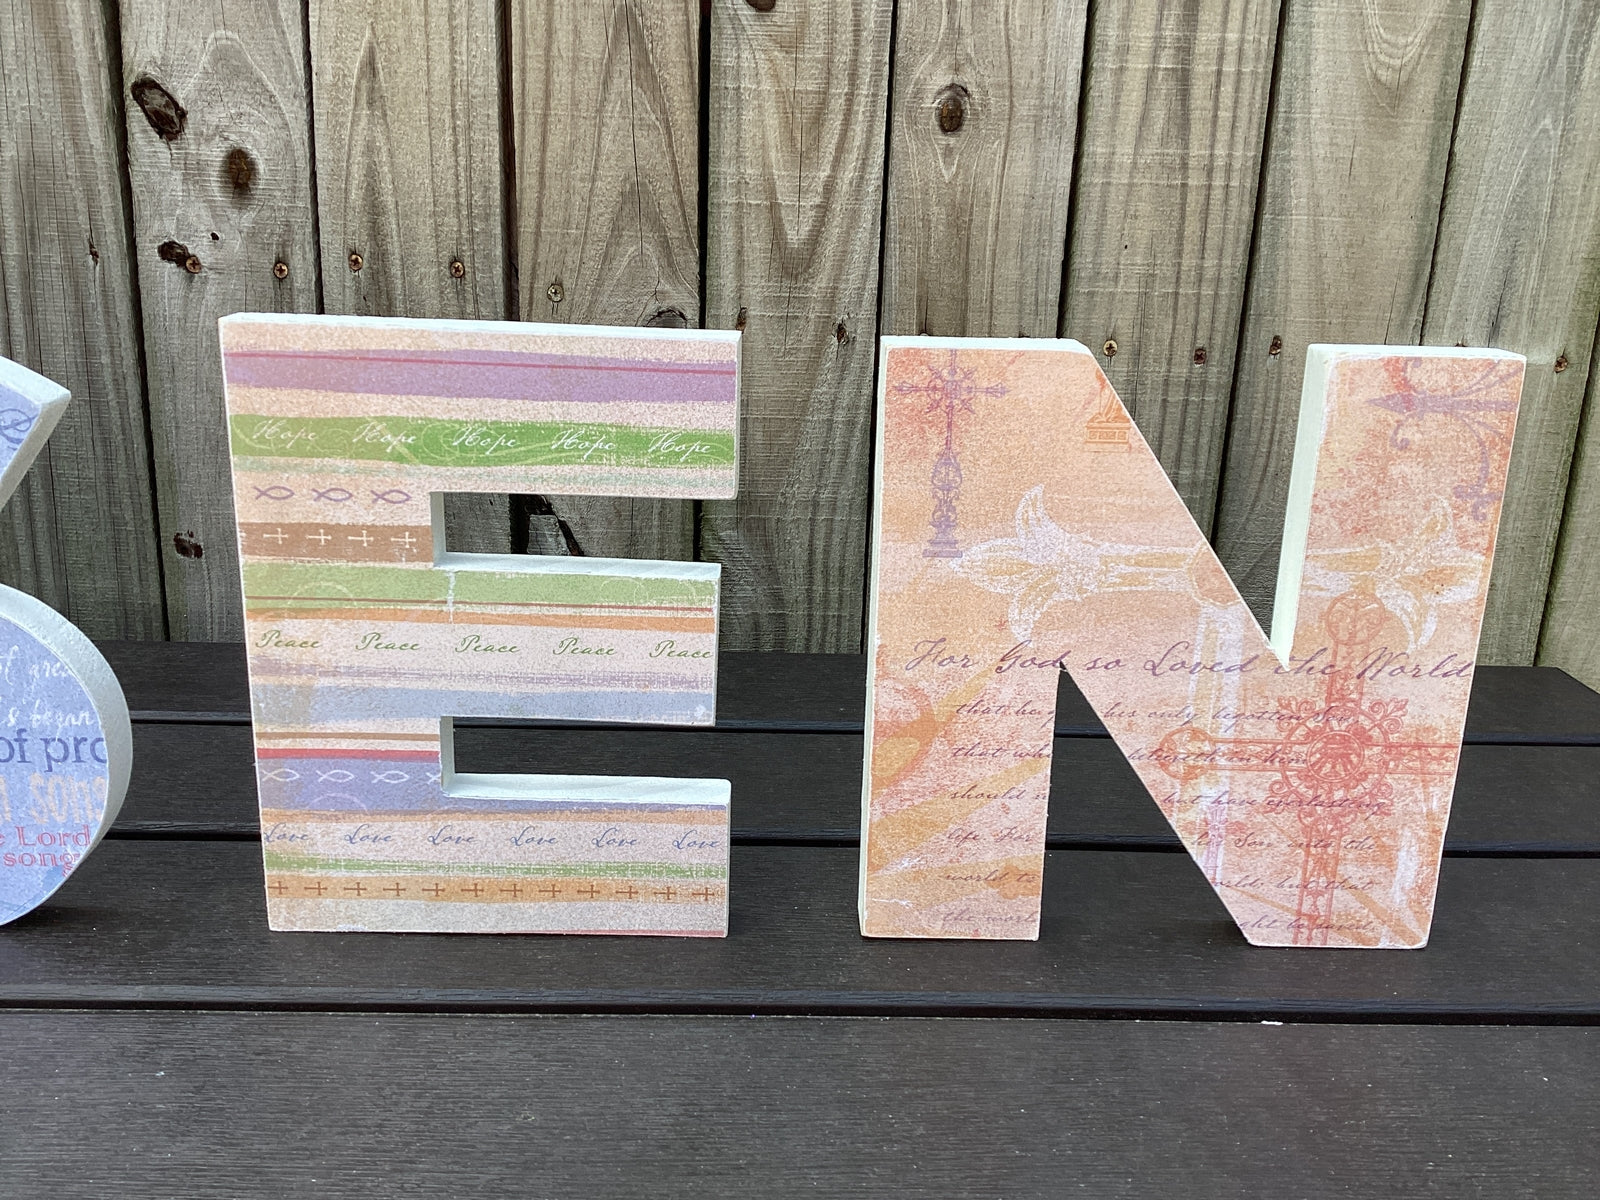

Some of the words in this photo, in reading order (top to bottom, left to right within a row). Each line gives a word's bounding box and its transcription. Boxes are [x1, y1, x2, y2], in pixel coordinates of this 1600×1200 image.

[252, 418, 318, 449] Hope
[353, 420, 417, 453] Hope
[451, 424, 520, 455] Hope
[551, 429, 616, 460] Hope
[647, 431, 711, 462] Hope
[255, 629, 321, 649] Peace
[355, 631, 423, 651] Peace
[454, 634, 520, 653] Peace
[552, 636, 616, 656] Peace
[649, 639, 714, 659] Peace
[904, 637, 977, 671] For
[995, 639, 1072, 674] God
[1085, 653, 1126, 671] so
[1143, 640, 1260, 677] Loved
[1355, 646, 1474, 681] World
[953, 699, 1012, 715] that
[1147, 704, 1199, 727] only
[1211, 705, 1304, 733] begotten
[952, 741, 1010, 759] that
[950, 784, 1026, 800] should
[15, 824, 91, 847] Lord
[263, 822, 309, 843] Love
[344, 823, 395, 845] Love
[429, 824, 479, 846] Love
[510, 825, 559, 847] Love
[592, 826, 638, 848] Love
[672, 829, 721, 850] Love
[946, 869, 1009, 883] world
